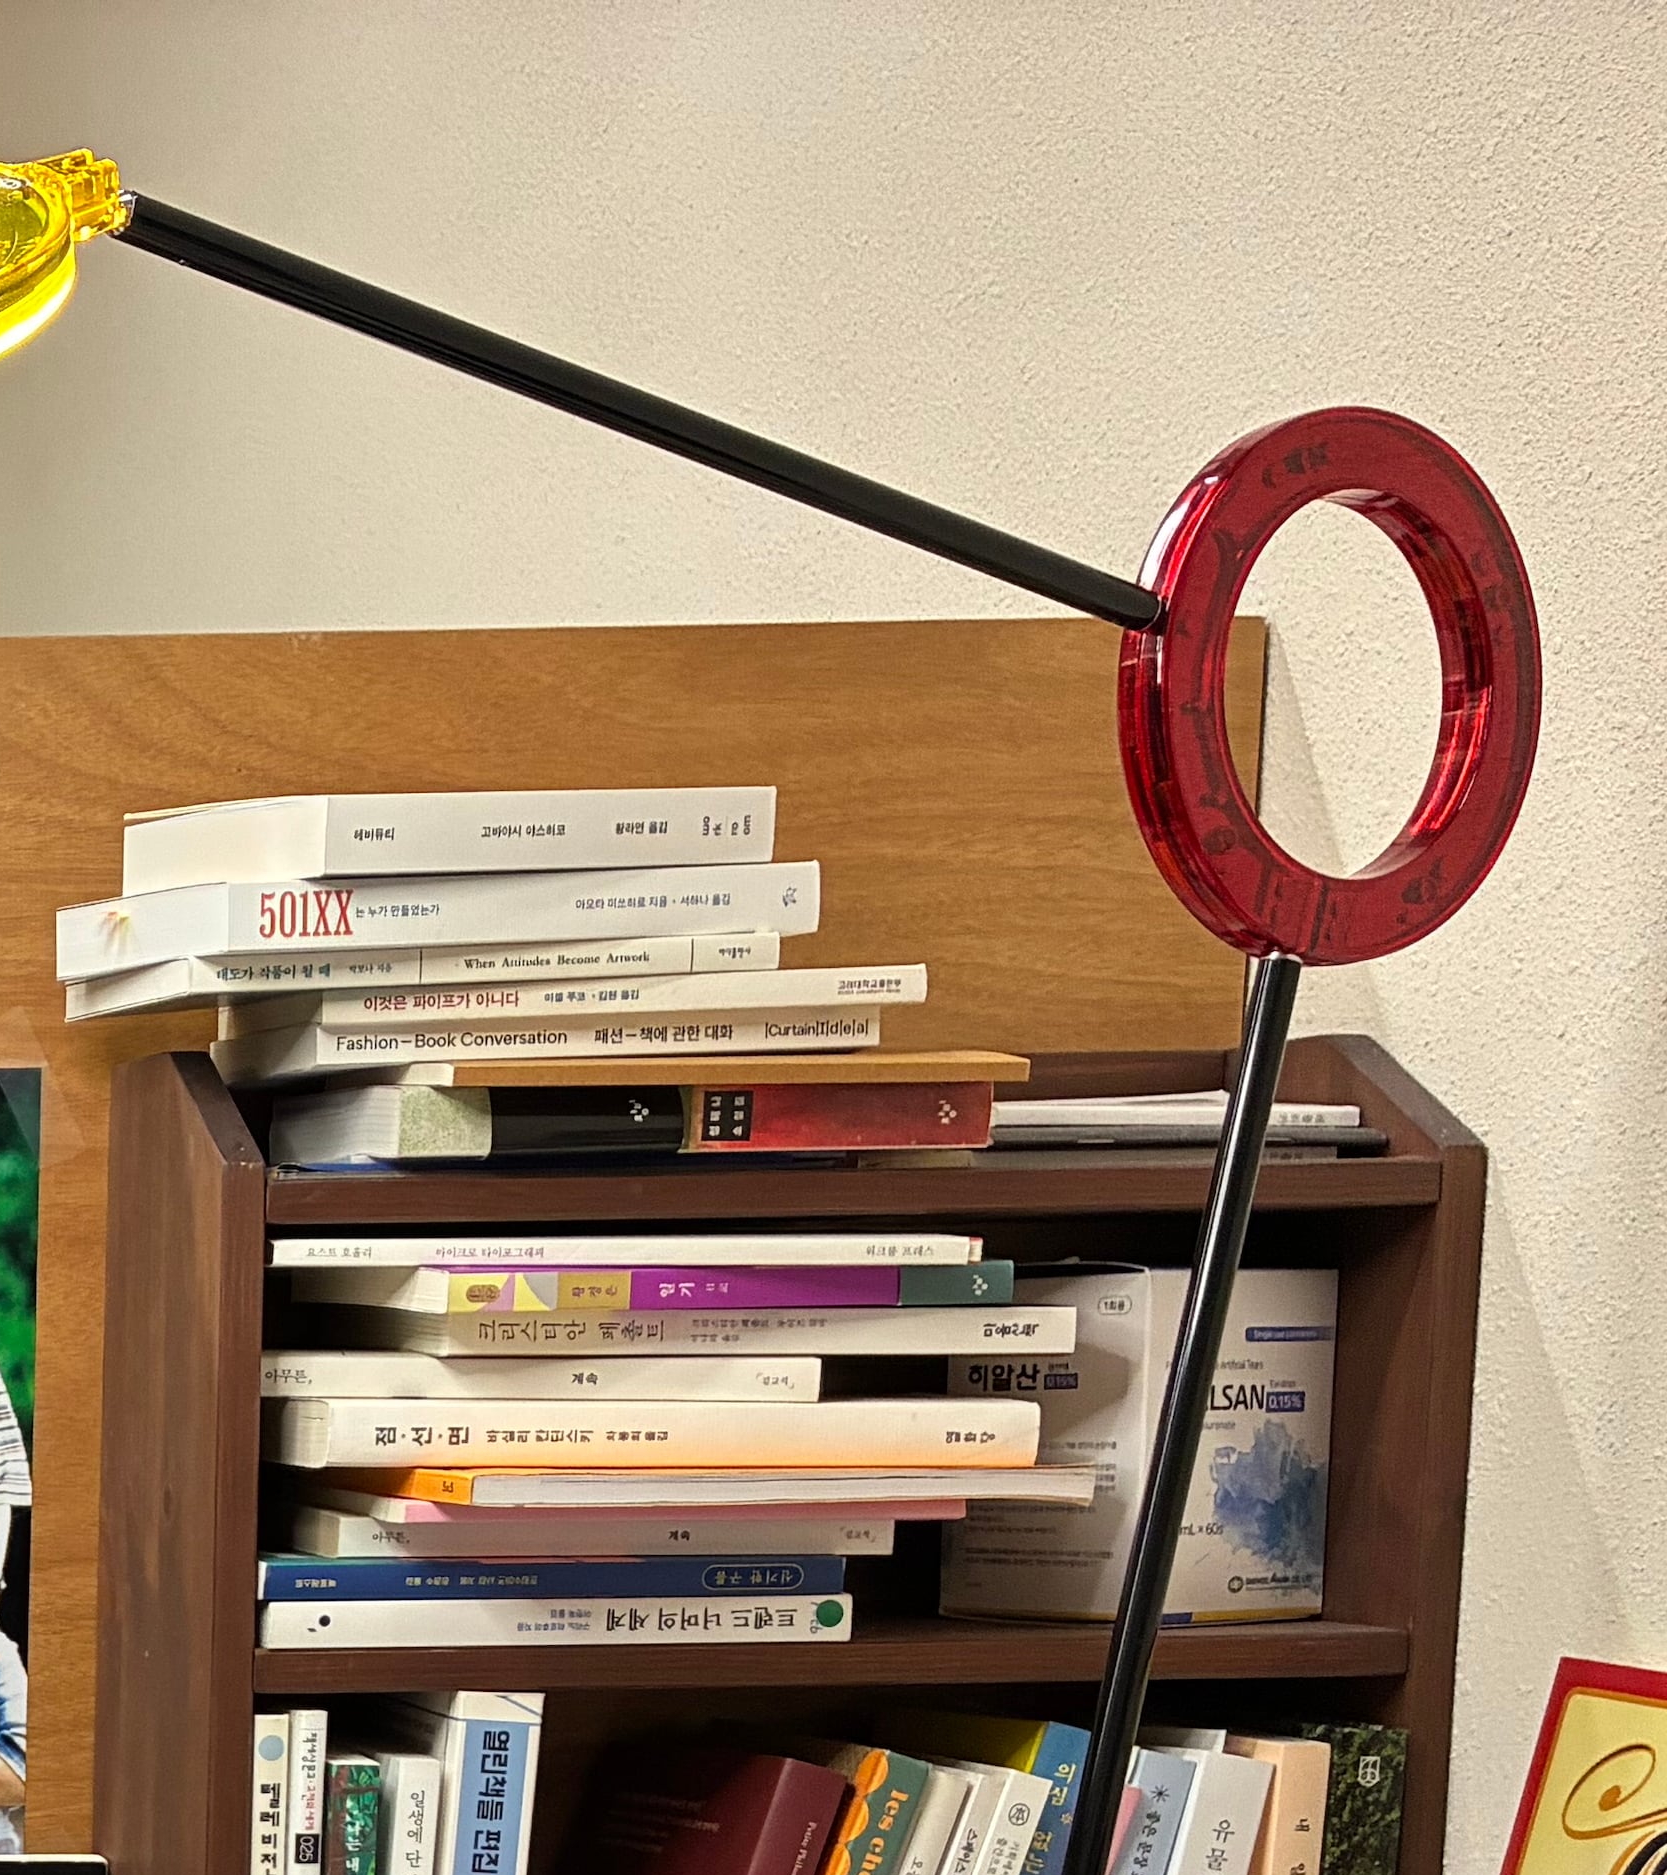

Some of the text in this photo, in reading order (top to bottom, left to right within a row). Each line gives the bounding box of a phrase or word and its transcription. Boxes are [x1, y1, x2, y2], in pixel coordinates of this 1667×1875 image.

[480, 824, 522, 839] 고바야시
[258, 889, 440, 939] 501XX 누가 만들었는가
[464, 951, 650, 970] When Attitudes Become Artwork
[363, 990, 520, 1012] 이것은 파이프가 아니다
[460, 1028, 568, 1048] Conversation
[673, 1025, 700, 1042] 관한
[704, 1024, 734, 1041] 대화
[477, 1321, 586, 1342] 크리스티안
[571, 1372, 599, 1386] 계속
[969, 1363, 1039, 1393] 히알산
[714, 1568, 794, 1585] 신기한 구름
[605, 1607, 650, 1631] 세계
[658, 1607, 723, 1630] 너머의
[730, 1608, 798, 1627] 트렌드
[476, 1729, 511, 1822] 열린책들
[877, 1789, 909, 1831] les
[298, 1835, 315, 1861] 025
[471, 1828, 502, 1875] 편집
